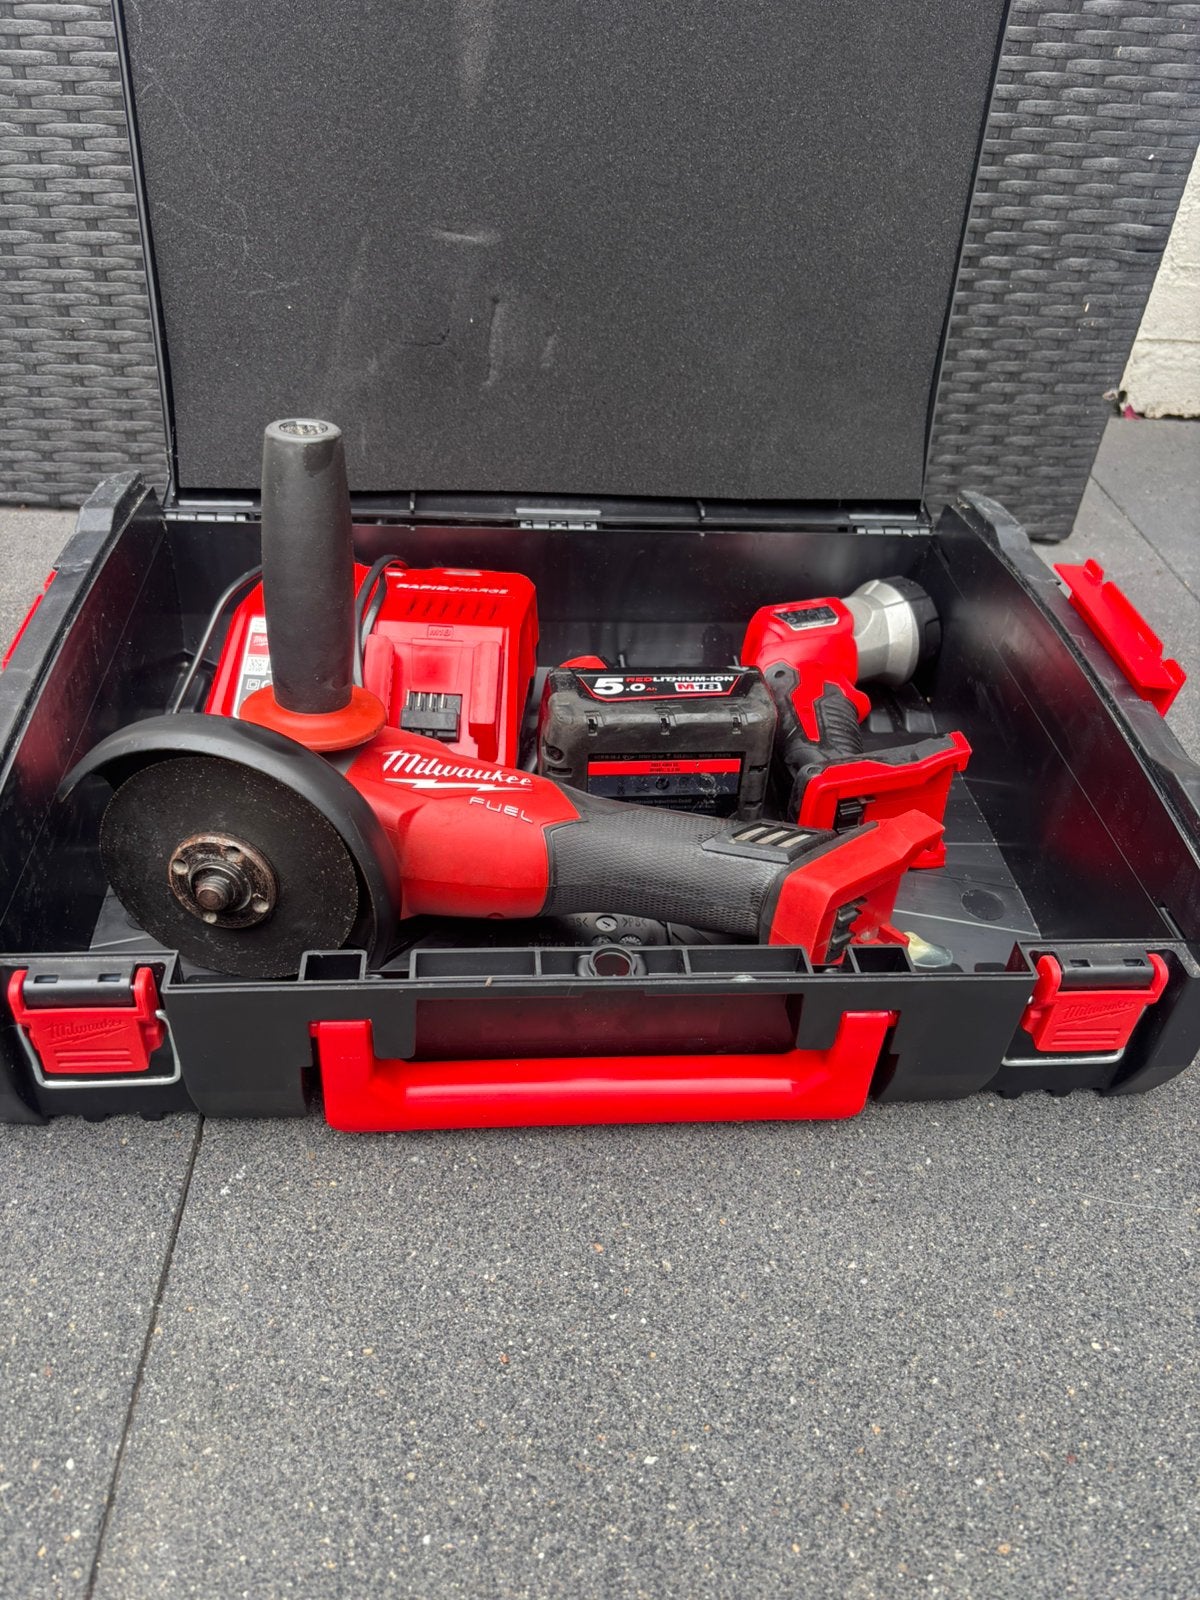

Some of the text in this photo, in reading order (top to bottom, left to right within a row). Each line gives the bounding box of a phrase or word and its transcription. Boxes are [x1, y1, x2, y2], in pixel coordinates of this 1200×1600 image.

[396, 583, 509, 595] RAPIDCHARGE
[592, 677, 646, 696] 5.0
[625, 675, 735, 683] REDLITHIUM-ION
[676, 683, 720, 692] M18
[382, 749, 534, 787] Milwaukee
[468, 796, 534, 824] FUEL
